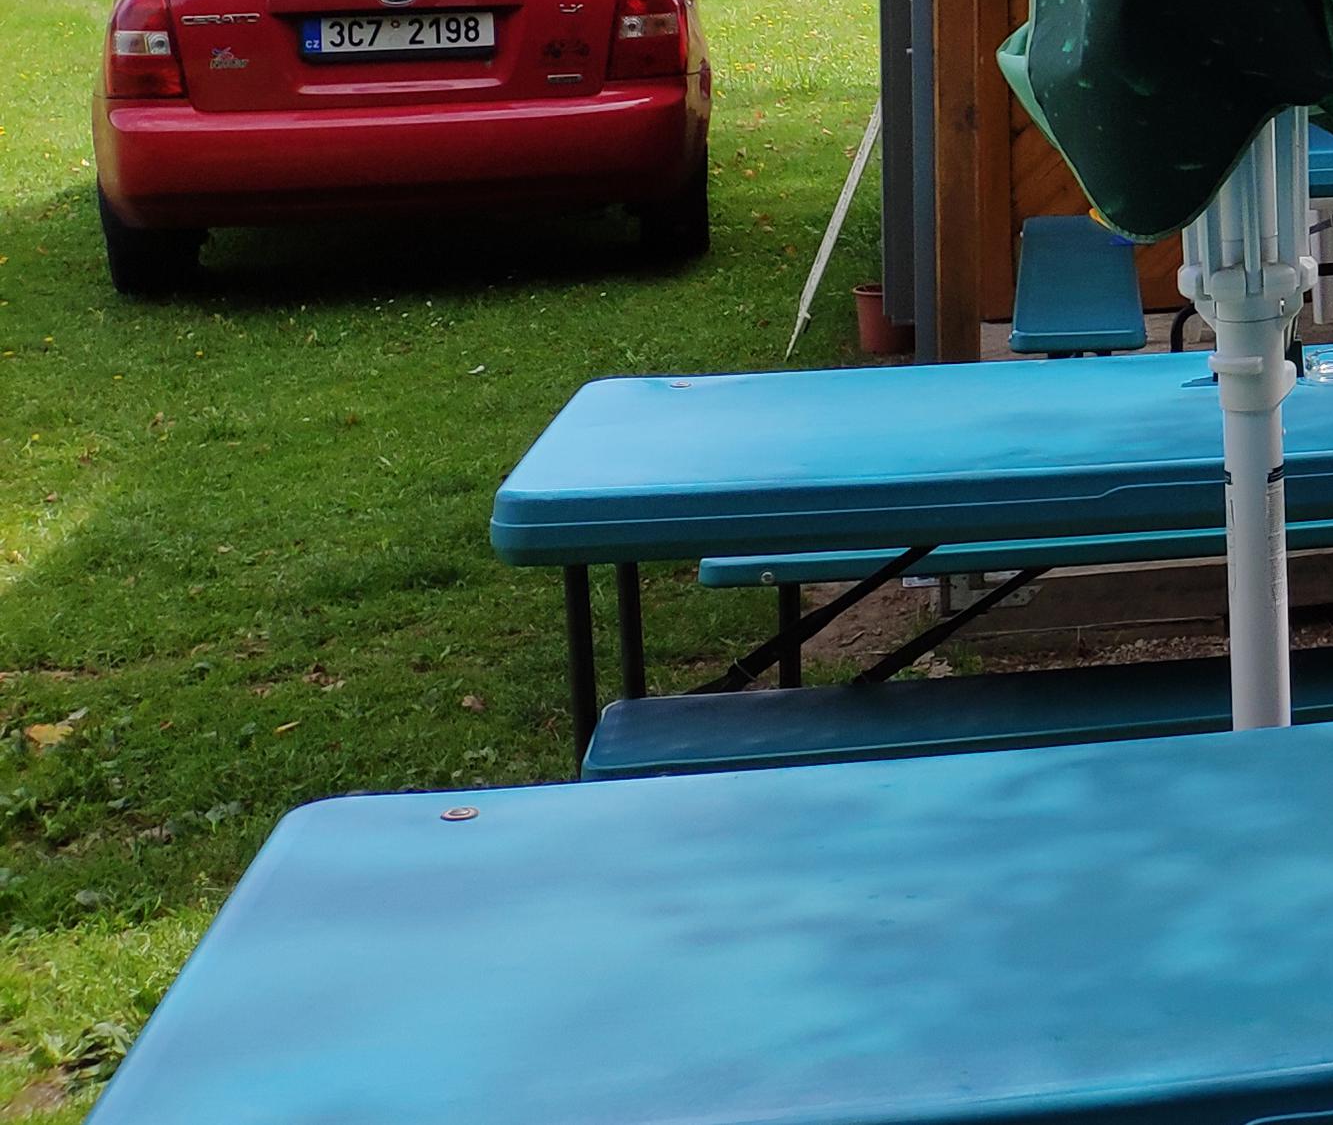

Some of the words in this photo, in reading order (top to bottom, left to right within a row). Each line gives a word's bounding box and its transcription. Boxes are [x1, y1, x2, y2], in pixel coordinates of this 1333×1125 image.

[328, 20, 384, 48] 3C7
[408, 16, 480, 45] 2198
[305, 40, 320, 49] CZ
